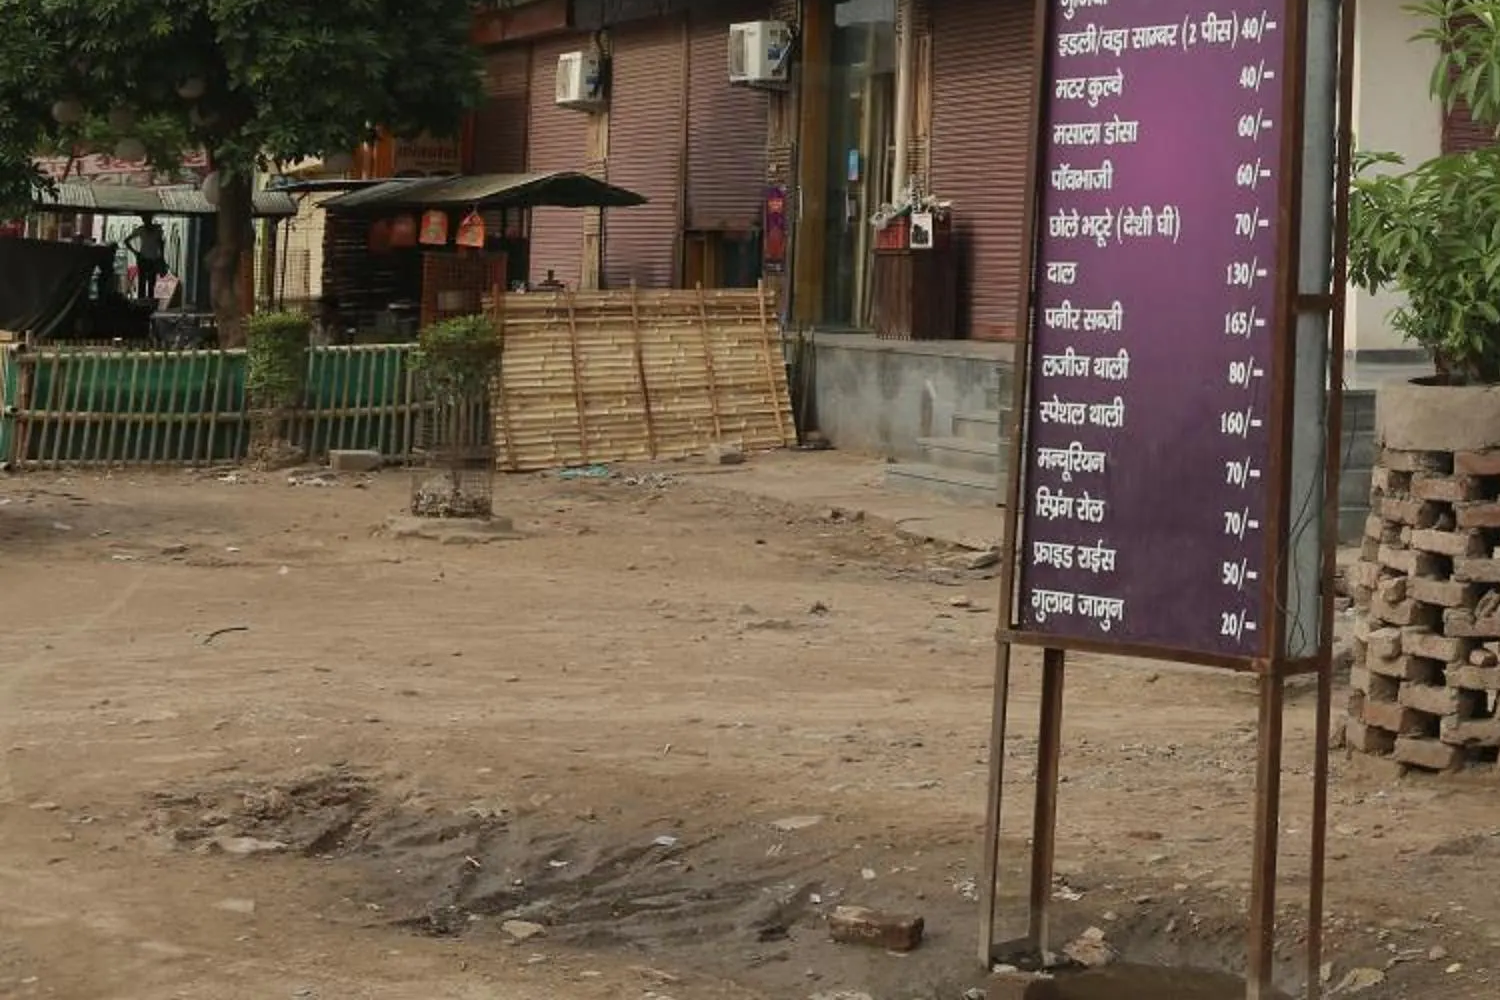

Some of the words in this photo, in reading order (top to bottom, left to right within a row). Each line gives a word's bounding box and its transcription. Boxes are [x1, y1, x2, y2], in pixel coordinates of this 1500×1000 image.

[1200, 11, 1238, 48] पीस)
[1241, 10, 1277, 43] 40/-
[1056, 77, 1086, 98] मटर
[1240, 59, 1274, 92] 40/-
[1053, 122, 1101, 145] मसाला
[1104, 113, 1139, 145] डोसा
[1238, 107, 1273, 141] 60/-
[1236, 157, 1271, 190] 60/-
[1049, 207, 1078, 237] छोले
[1118, 205, 1152, 248] (देशी
[1157, 205, 1180, 247] घी)
[1235, 206, 1269, 240] 70/-
[1047, 261, 1078, 284] दाल
[1227, 256, 1267, 288] 130/-
[1046, 299, 1079, 330] पनीर
[1225, 304, 1265, 338] 165/-
[1042, 346, 1090, 377] लजीज
[1093, 349, 1129, 381] थाली
[1229, 355, 1263, 389] 80/-
[1040, 394, 1086, 426] स्पेशल
[1089, 396, 1124, 428] थाली
[1221, 405, 1262, 439] 160/-
[1226, 456, 1261, 489] 70/-
[1076, 490, 1105, 523] रोल
[1224, 507, 1259, 540] 70/-
[1033, 540, 1073, 570] फ्राइड
[1222, 557, 1257, 591] 50/-
[1031, 588, 1073, 623] गुलाब
[1078, 593, 1124, 632] जामुन
[1220, 607, 1256, 640] 20/-
